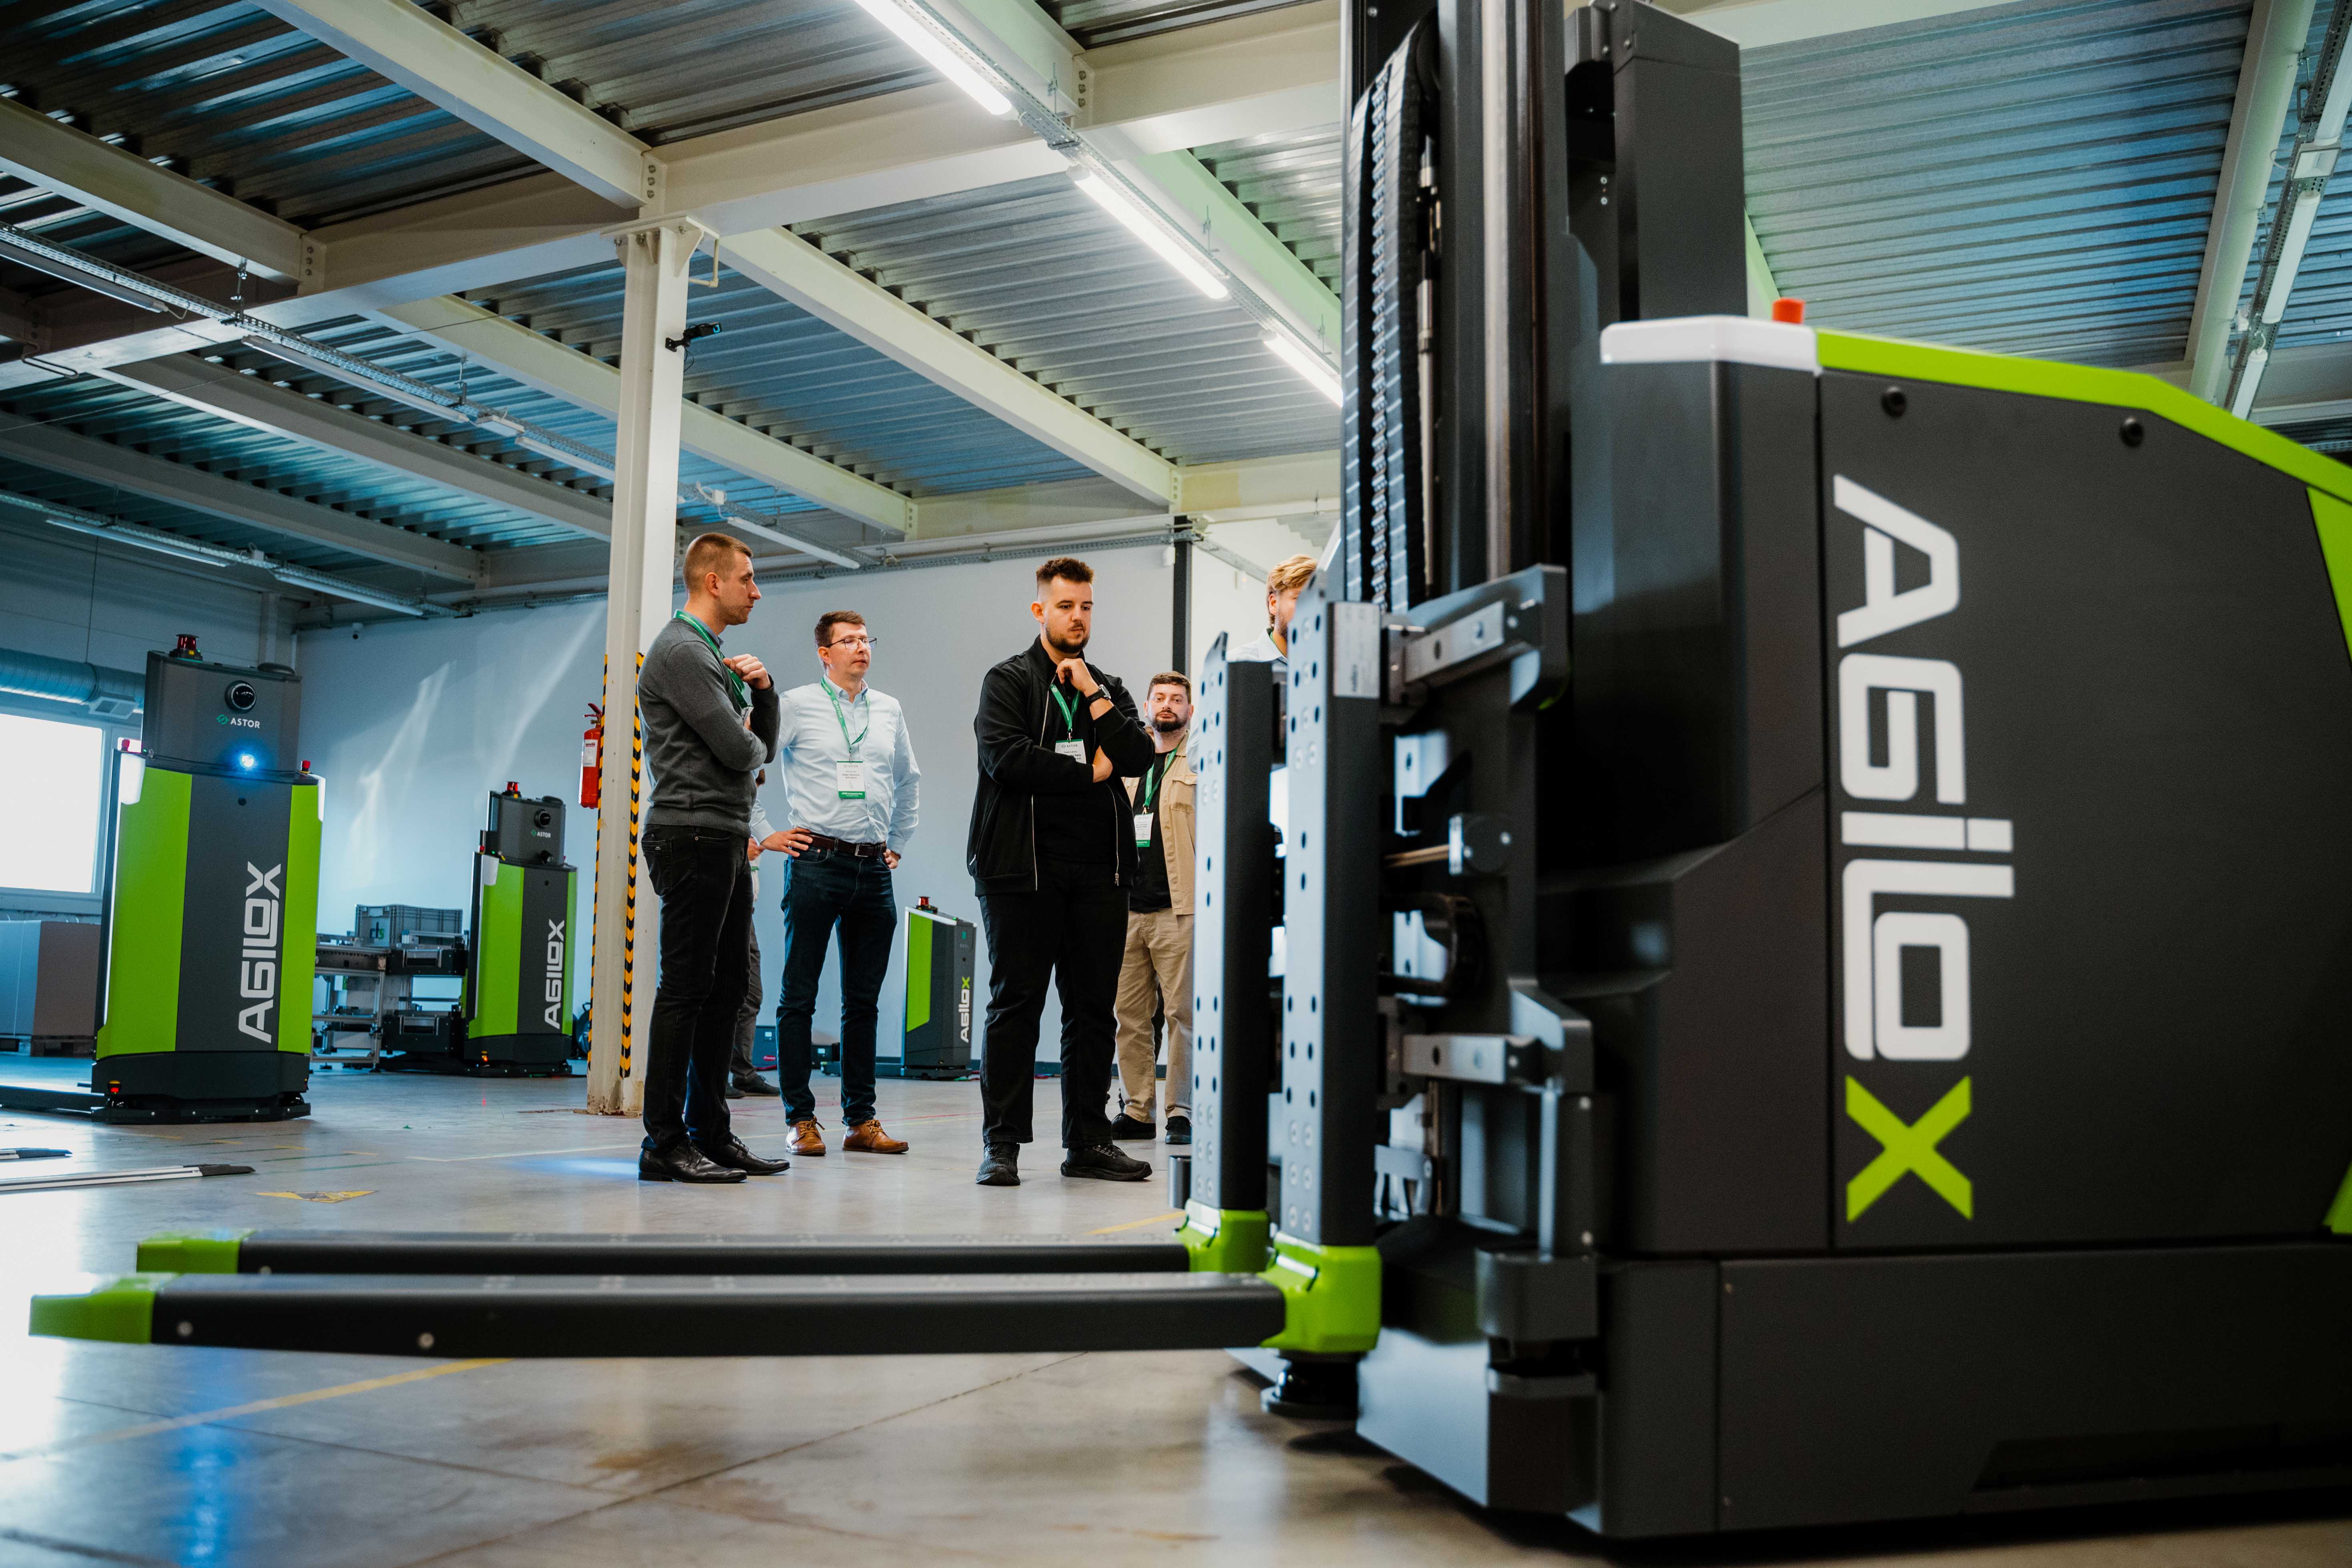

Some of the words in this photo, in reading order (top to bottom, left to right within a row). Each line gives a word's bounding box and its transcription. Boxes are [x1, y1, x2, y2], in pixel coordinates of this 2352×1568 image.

[230, 717, 260, 729] ASTOR
[238, 861, 281, 1043] AGILOX
[544, 919, 565, 1029] AGILOX
